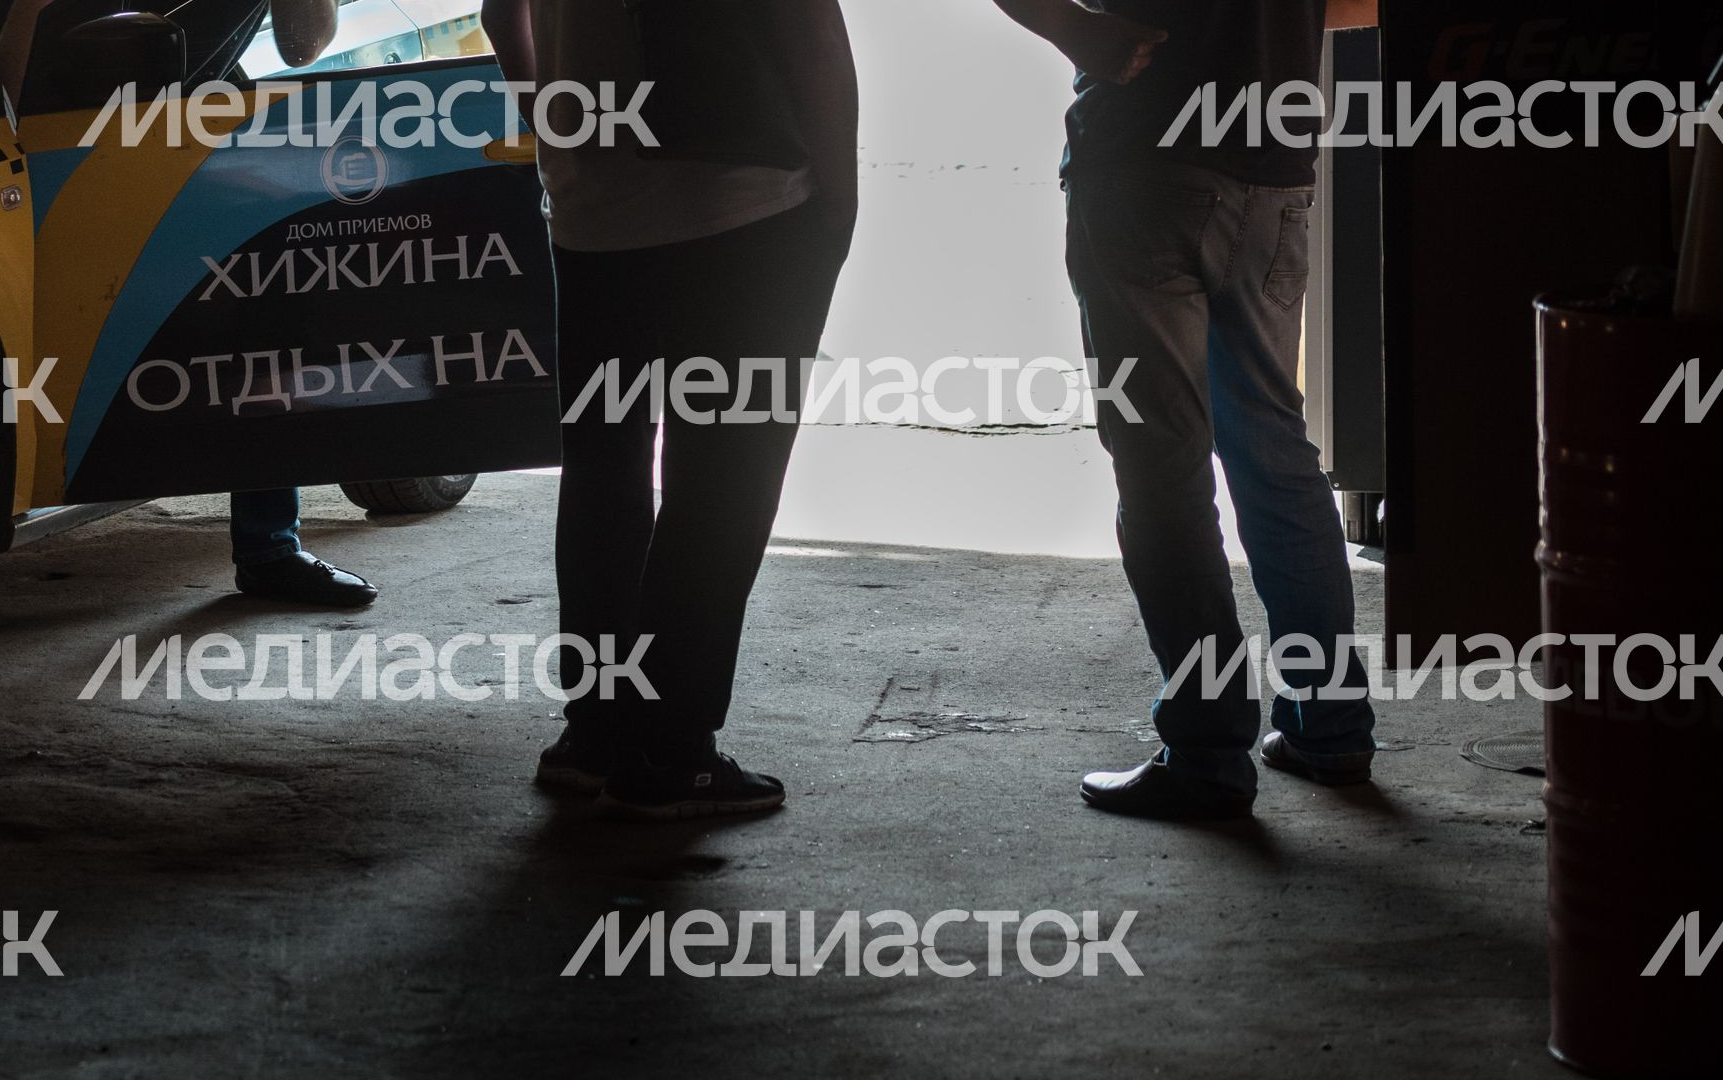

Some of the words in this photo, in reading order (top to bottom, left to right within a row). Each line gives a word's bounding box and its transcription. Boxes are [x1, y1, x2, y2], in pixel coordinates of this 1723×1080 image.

[286, 222, 334, 243] ДОМ
[338, 213, 433, 238] ПРИЕМОВ
[197, 231, 525, 302] ХИЖИНА
[126, 336, 418, 417] ОТДЫХ
[431, 328, 551, 387] НА
